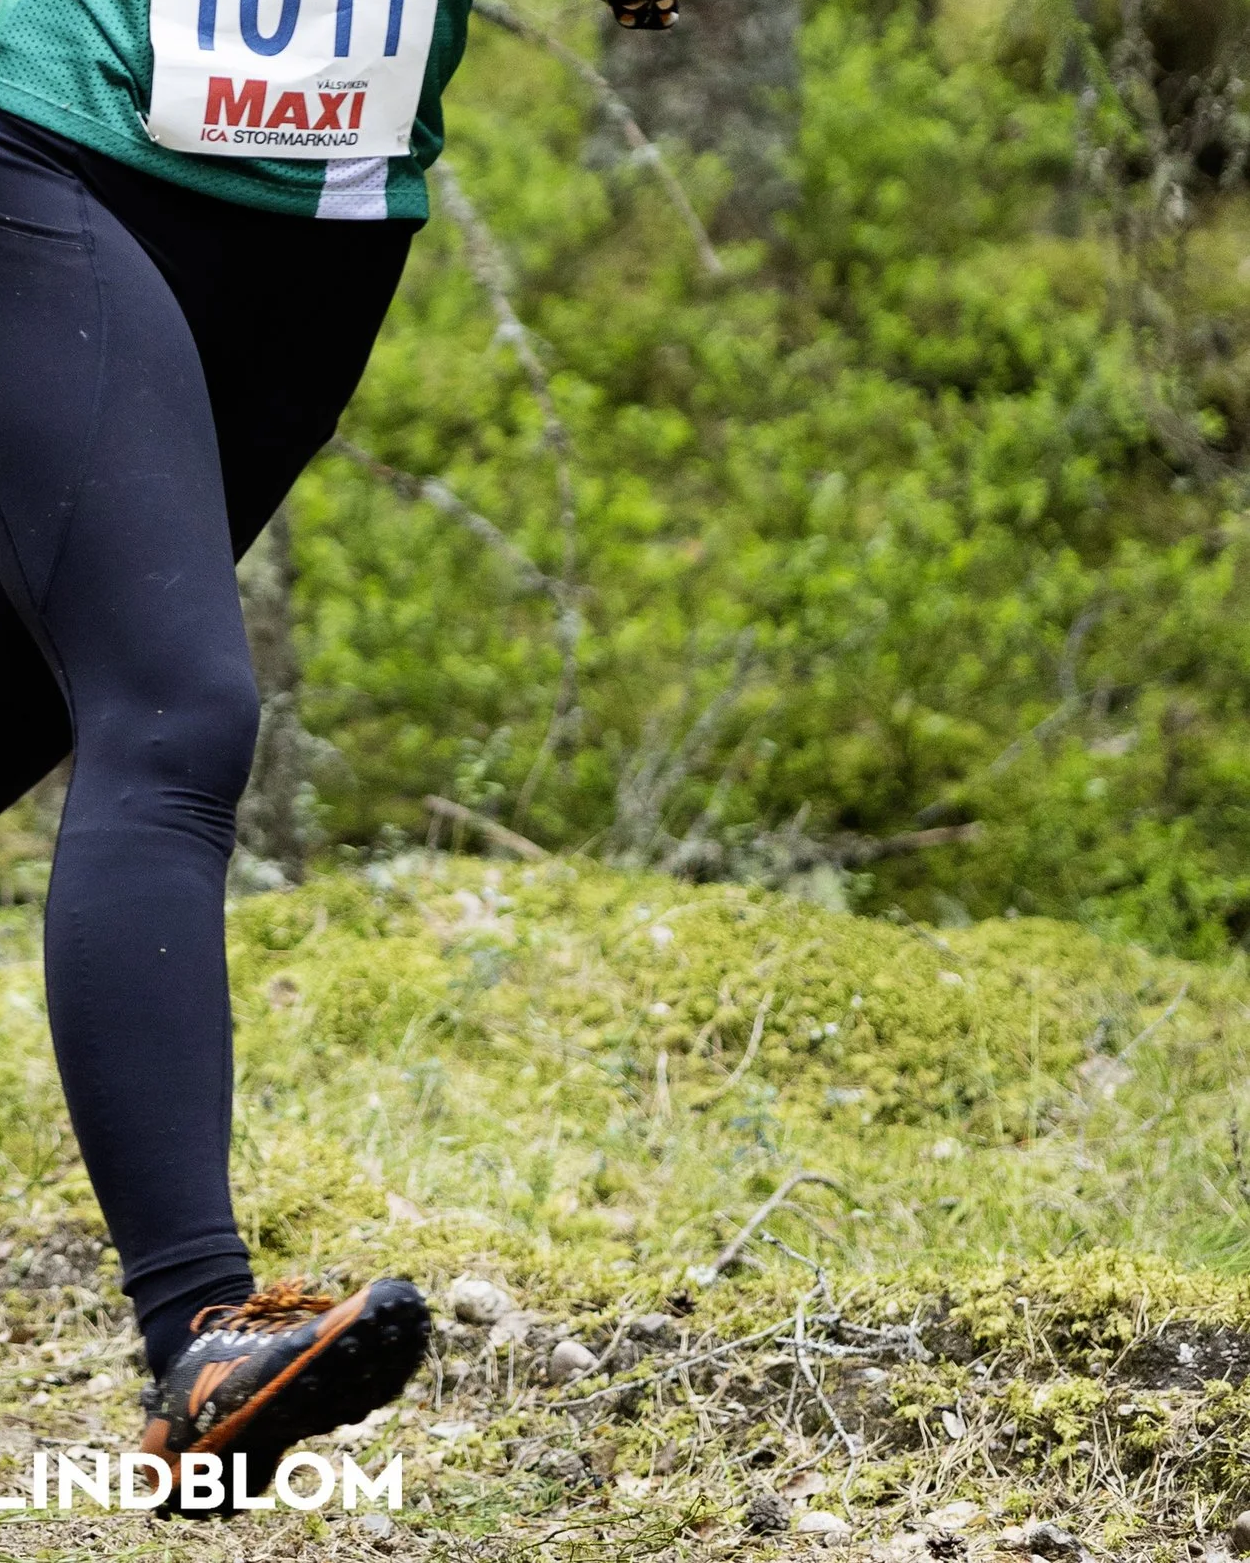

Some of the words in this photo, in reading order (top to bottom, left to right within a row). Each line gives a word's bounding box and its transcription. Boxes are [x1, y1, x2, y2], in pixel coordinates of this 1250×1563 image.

[204, 76, 366, 130] MAXI
[200, 128, 228, 143] ICA
[233, 129, 358, 146] STORMARKNAD
